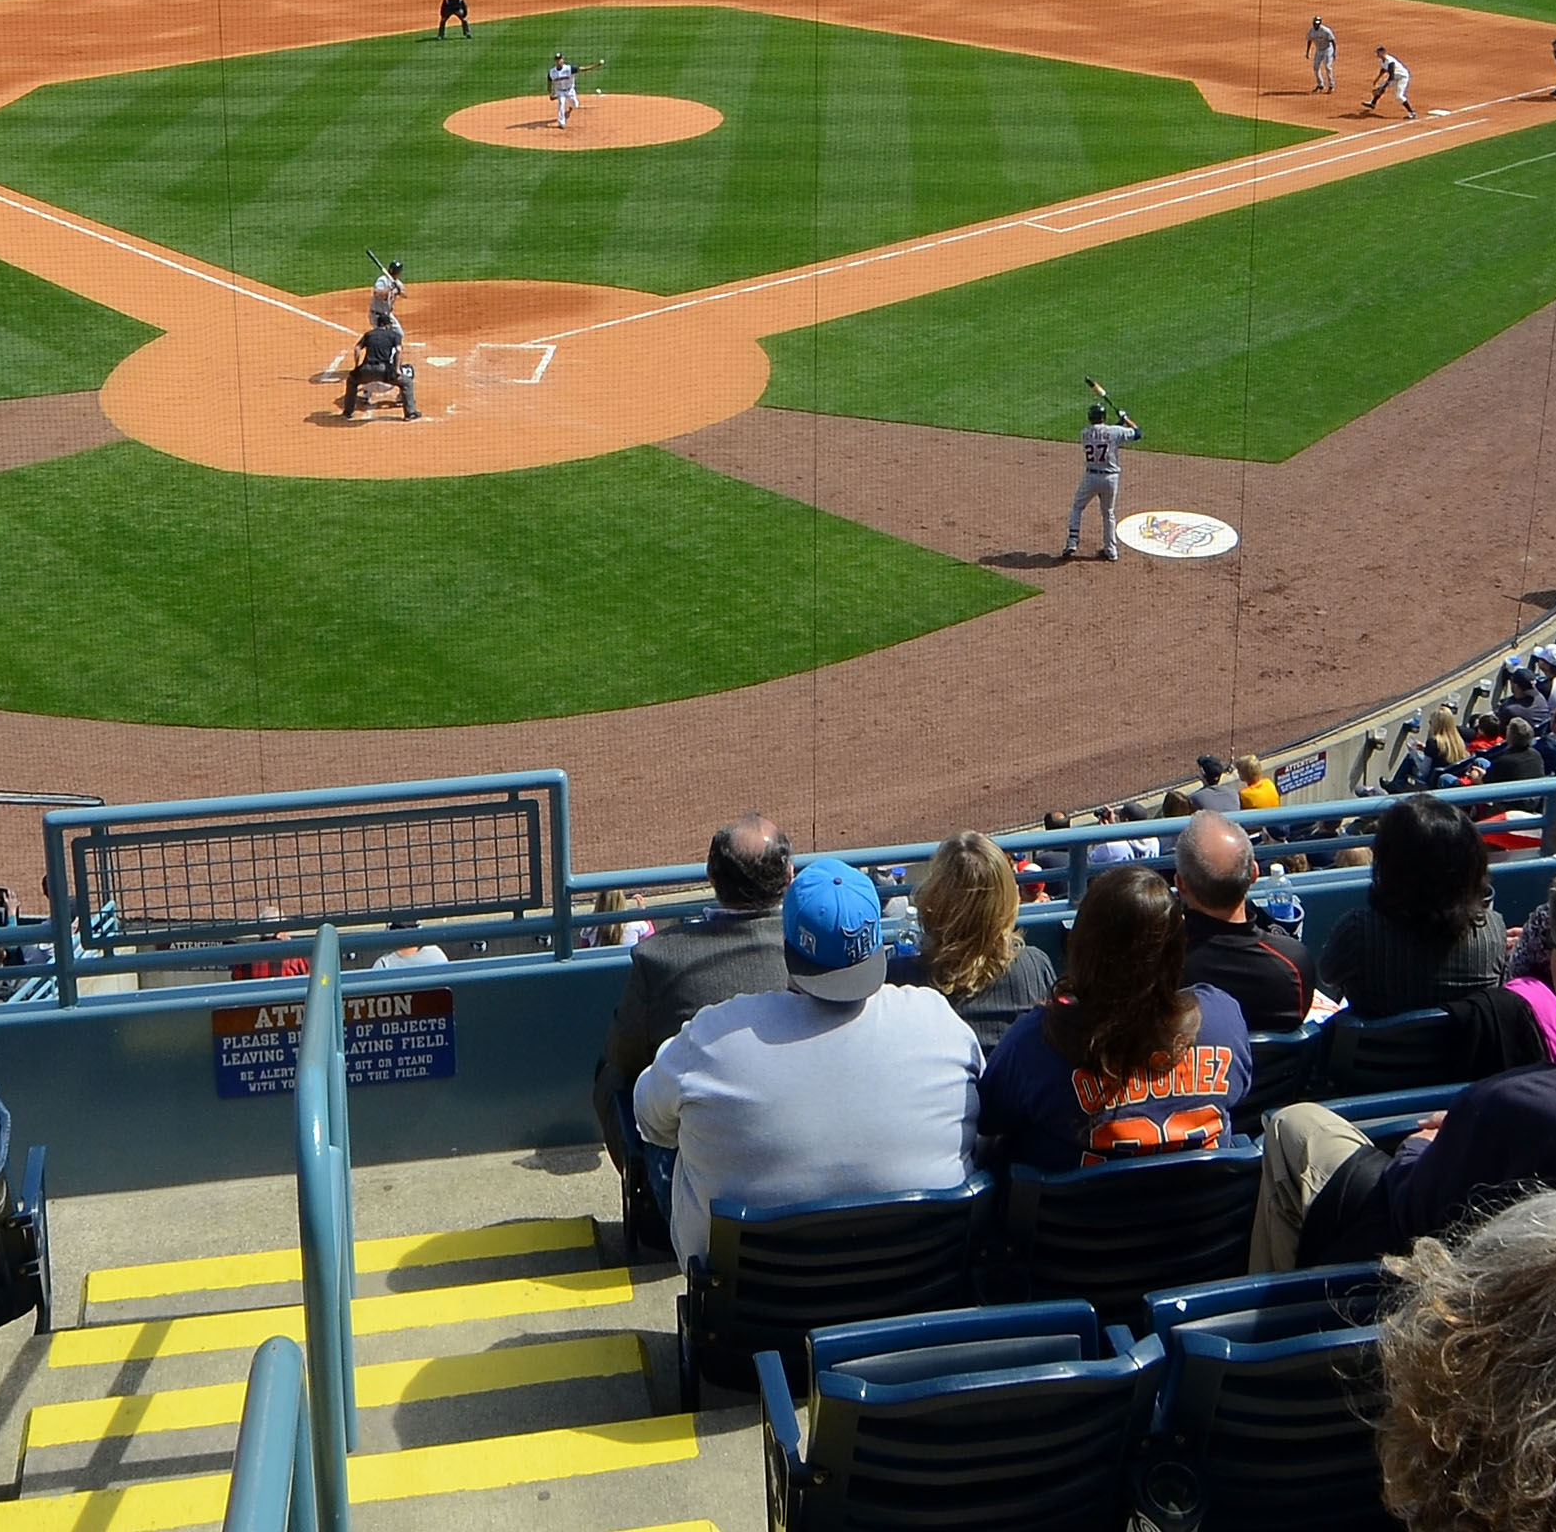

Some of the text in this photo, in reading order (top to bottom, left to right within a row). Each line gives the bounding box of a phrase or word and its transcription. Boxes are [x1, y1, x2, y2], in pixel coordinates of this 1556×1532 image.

[1085, 444, 1108, 462] 27
[255, 995, 412, 1029] ATTTION
[223, 1033, 280, 1050] PLEASE
[356, 1026, 373, 1037] OF
[382, 1018, 447, 1035] OBJECTS
[222, 1047, 285, 1066] LEAVING
[402, 1034, 449, 1050] FIELD.
[241, 1054, 433, 1081] BE ALERT SIT OR STAND
[249, 1082, 276, 1092] WITH
[349, 1073, 362, 1082] TO
[368, 1071, 389, 1081] THE
[395, 1068, 429, 1079] FIELD.
